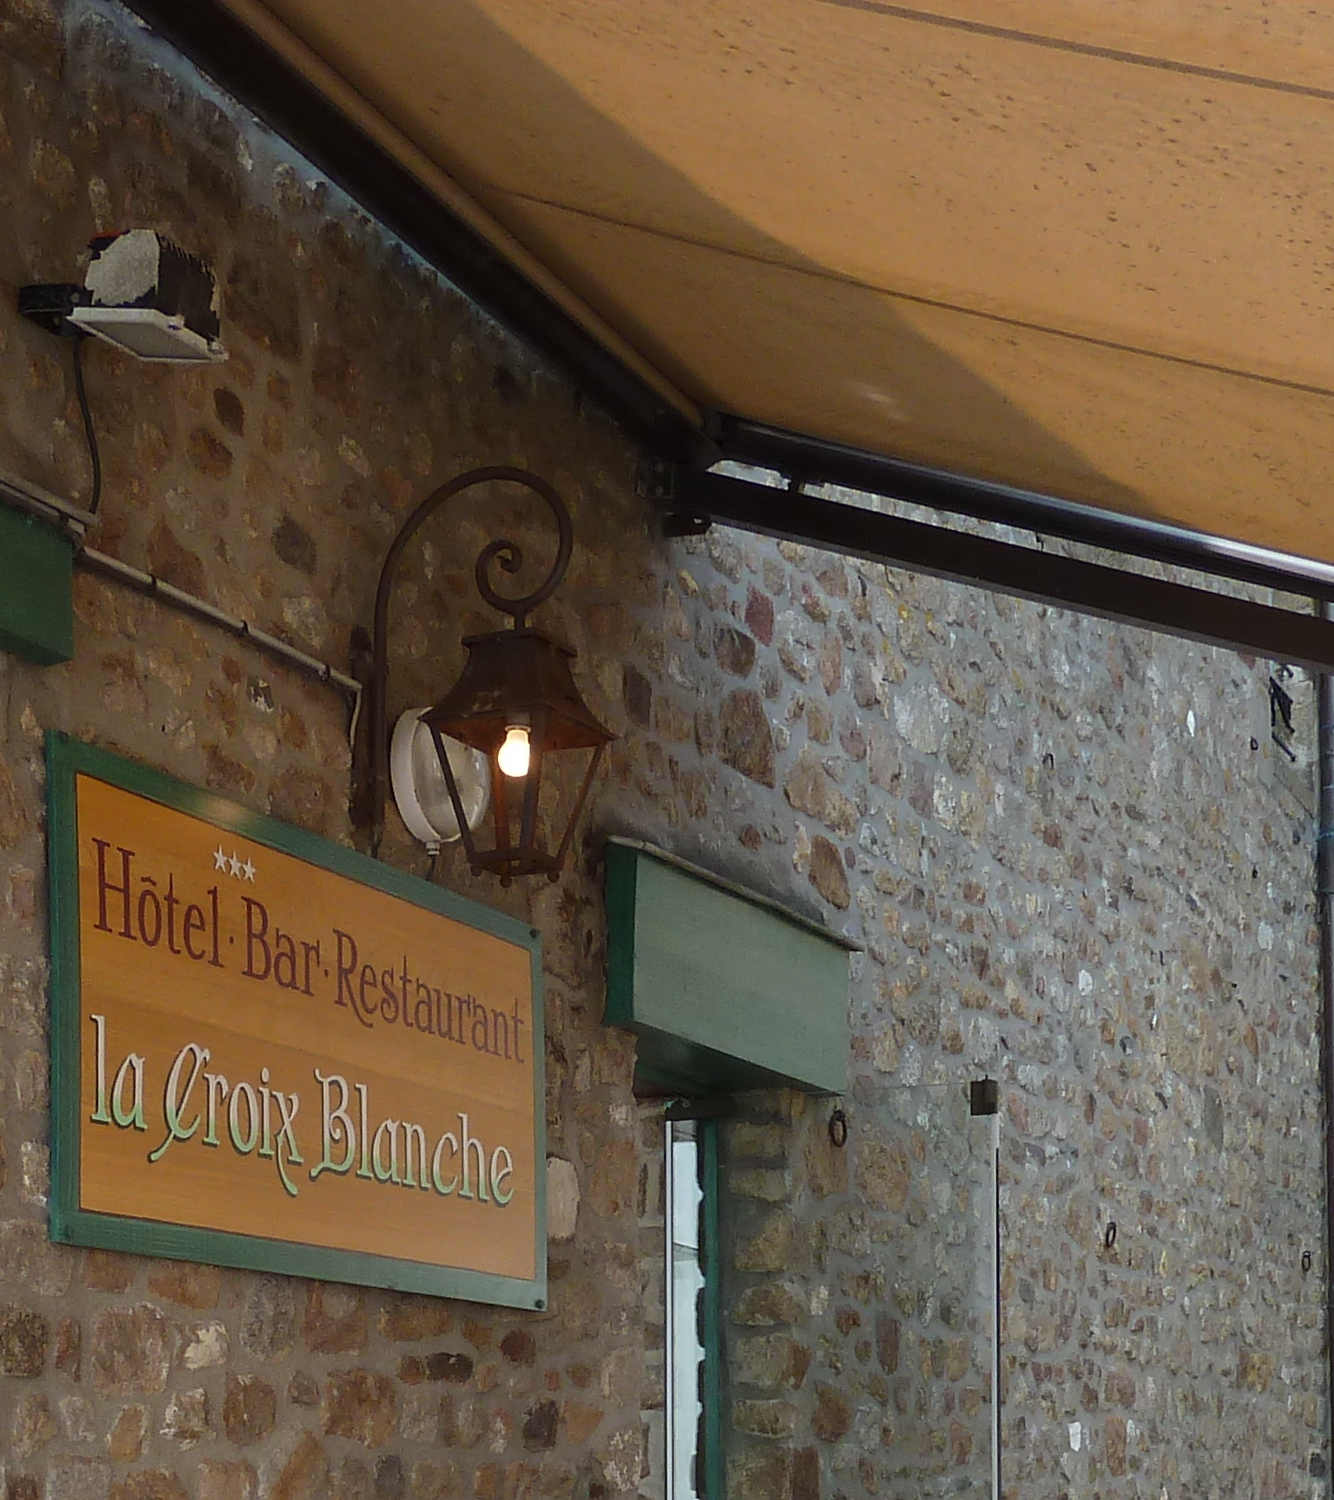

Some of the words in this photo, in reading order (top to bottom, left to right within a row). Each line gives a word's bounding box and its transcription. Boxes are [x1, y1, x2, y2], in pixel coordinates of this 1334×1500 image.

[91, 837, 224, 968] Hôtel
[241, 896, 320, 997] Bar
[332, 928, 525, 1064] Restaurant
[90, 1014, 148, 1131] la
[148, 1042, 304, 1196] Croix
[309, 1068, 514, 1207] Blanche
